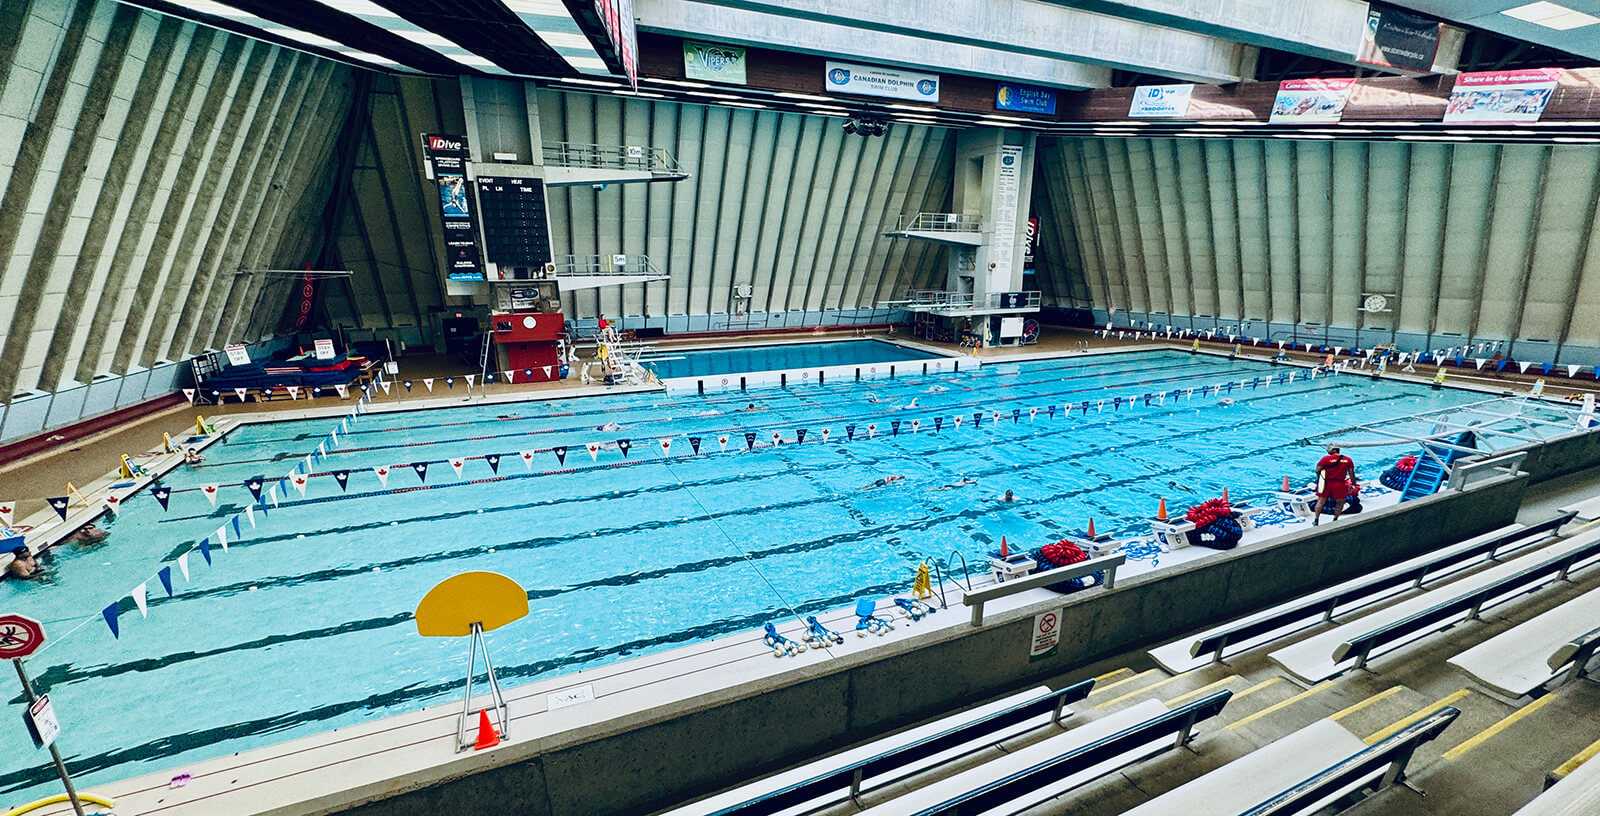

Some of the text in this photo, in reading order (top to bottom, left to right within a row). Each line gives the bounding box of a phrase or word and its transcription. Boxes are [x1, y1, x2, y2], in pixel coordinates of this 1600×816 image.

[695, 47, 730, 70] VIPERS
[853, 75, 914, 88] CANADIAN DOLPHIN
[1464, 75, 1483, 83] Share
[1036, 98, 1048, 107] Club
[629, 147, 641, 156] 10m
[614, 255, 626, 263] 5m
[1241, 518, 1247, 527] 5
[1175, 534, 1182, 544] 6
